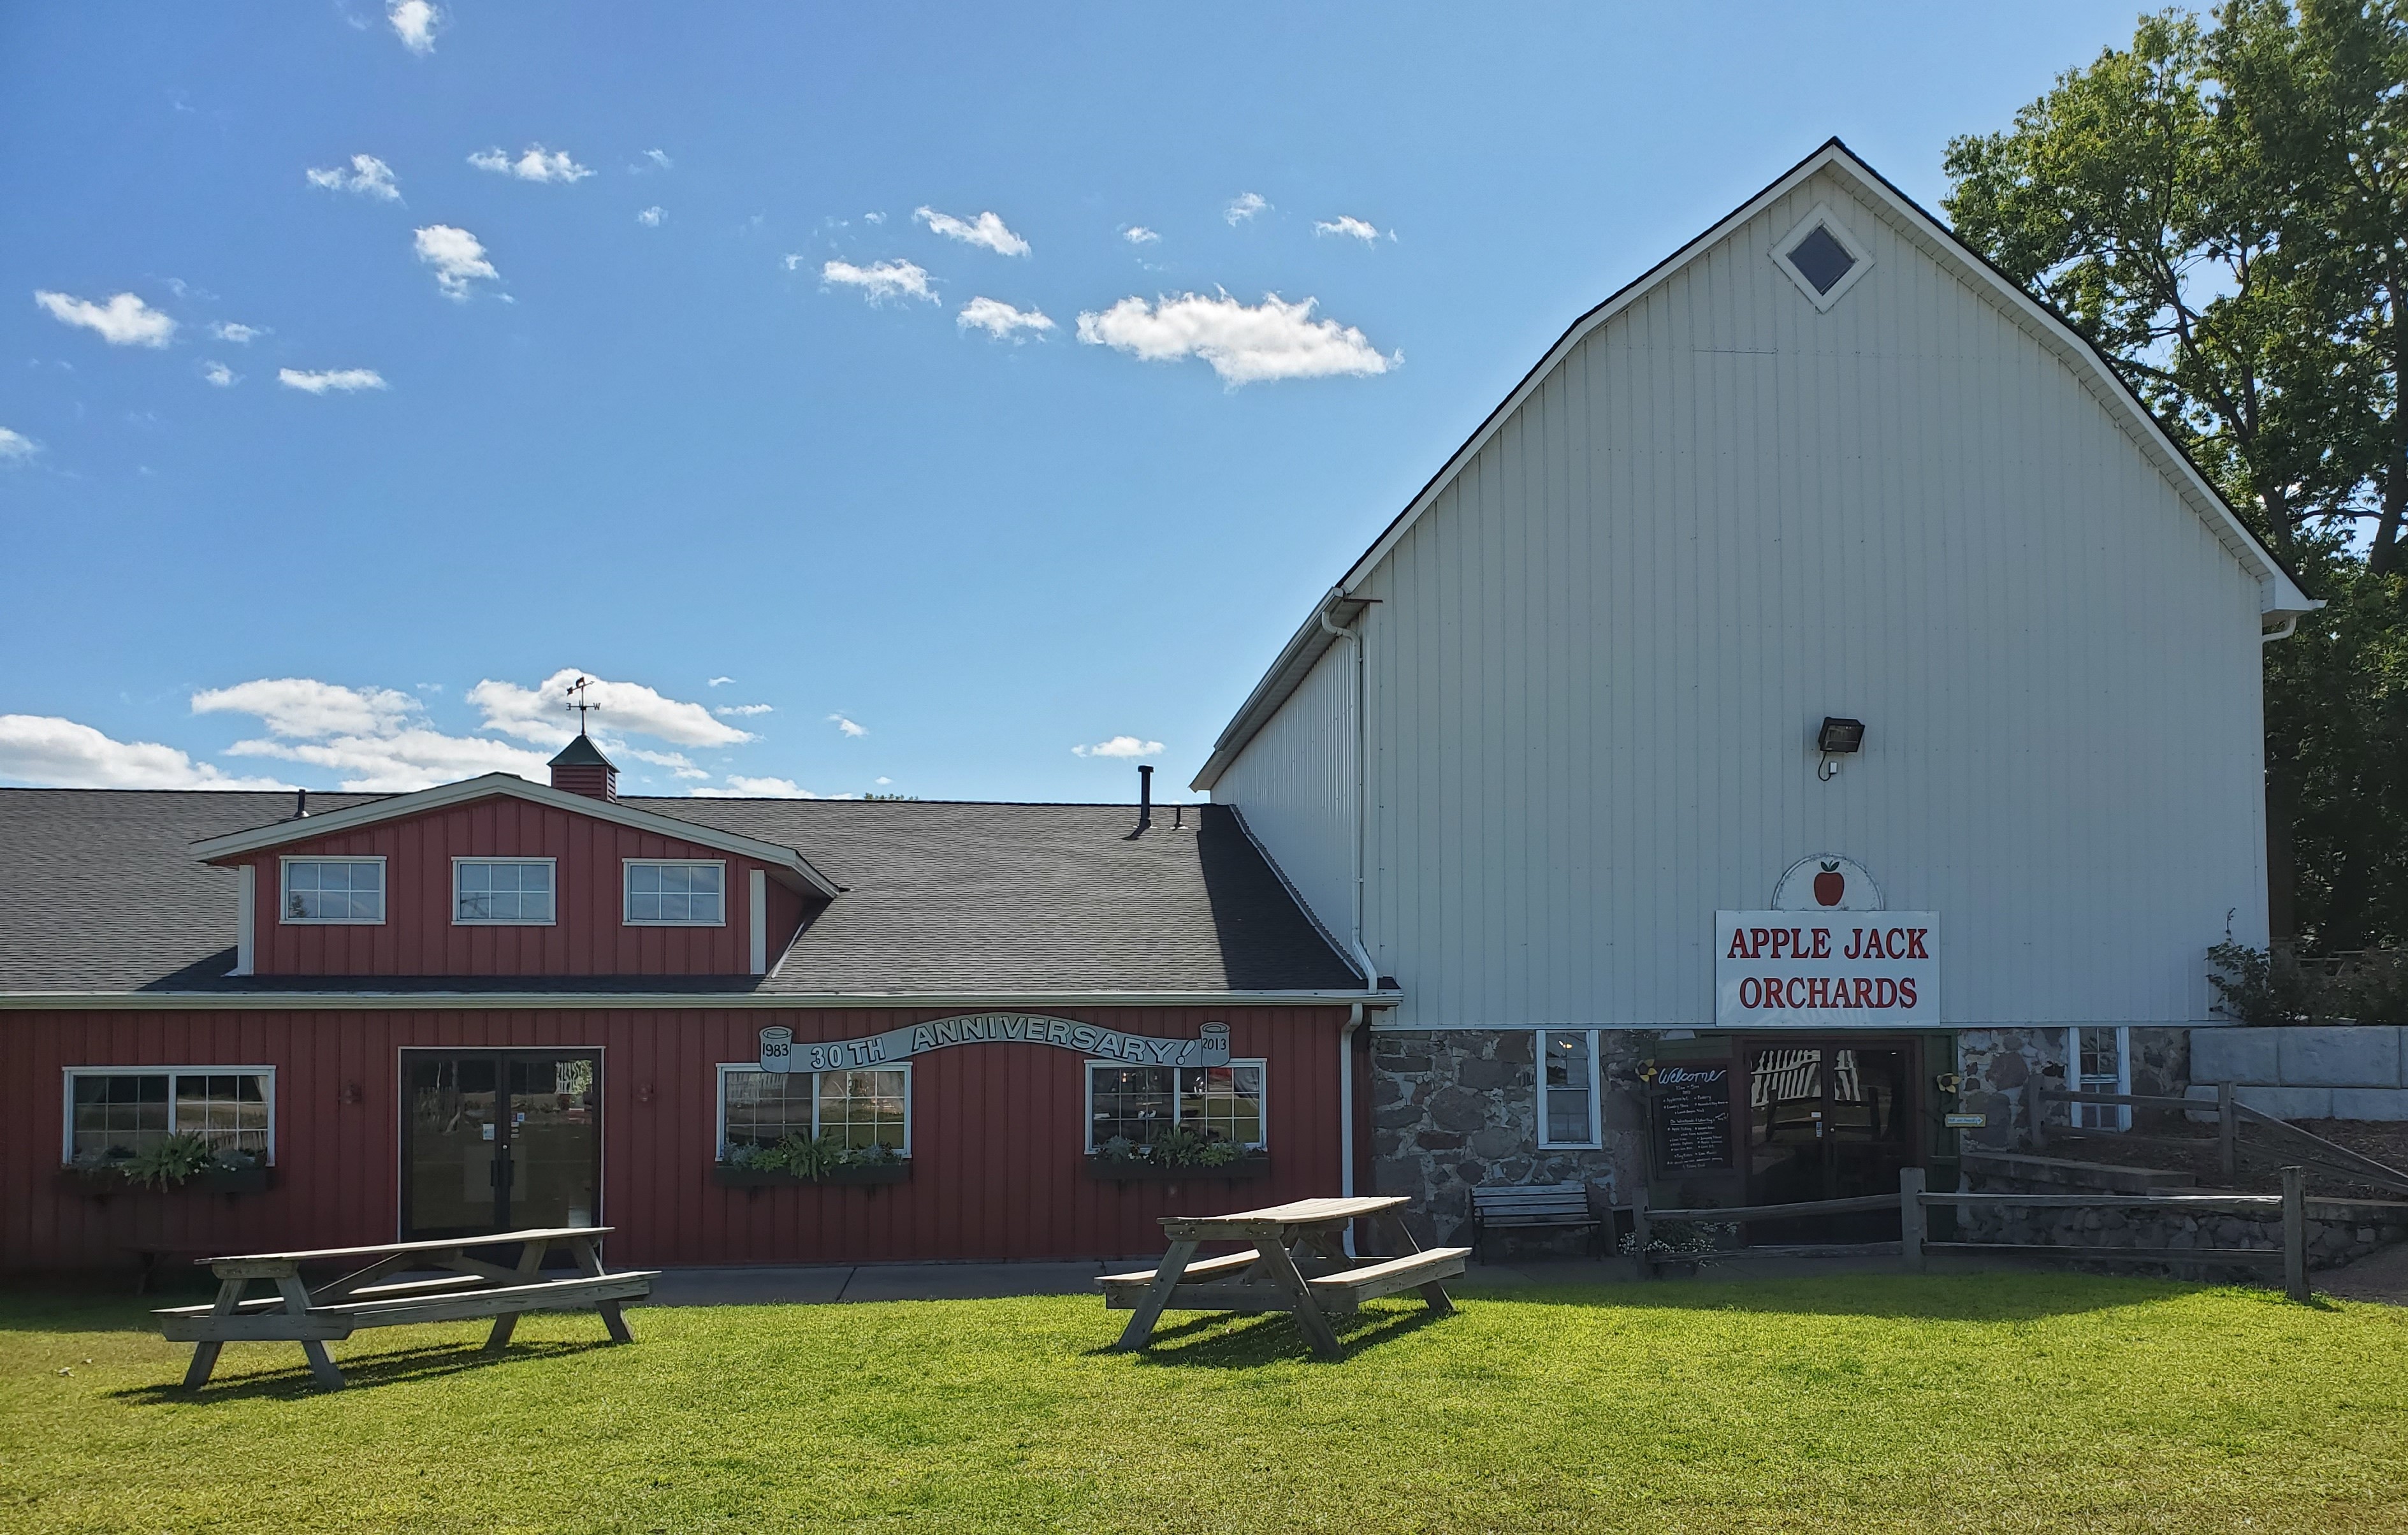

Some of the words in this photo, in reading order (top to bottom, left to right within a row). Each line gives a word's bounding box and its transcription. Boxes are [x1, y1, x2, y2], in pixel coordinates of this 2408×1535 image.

[1727, 928, 1832, 959] APPLE
[1843, 928, 1929, 959] JACK
[1739, 977, 1918, 1009] ORCHARDS
[762, 1042, 790, 1058] 1983
[911, 1015, 1196, 1066] ANNIVERSARY!
[1201, 1037, 1228, 1051] 2013
[1658, 1067, 1727, 1084] Welcome
